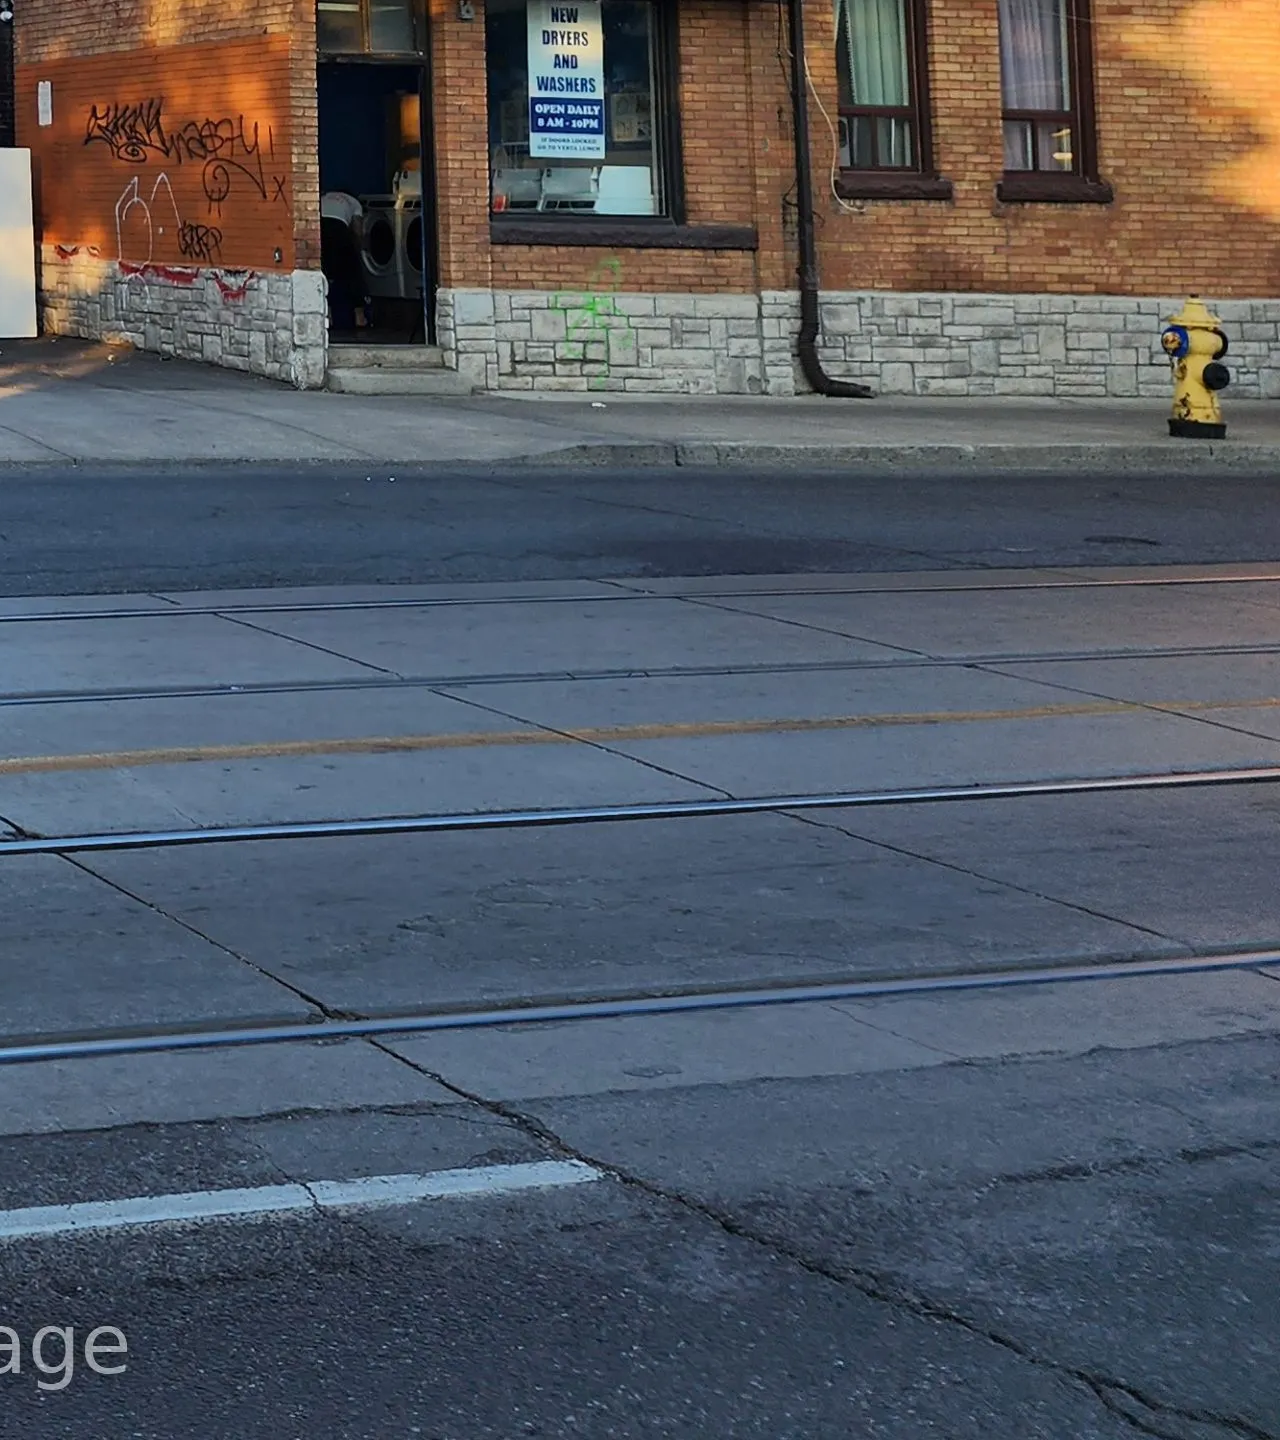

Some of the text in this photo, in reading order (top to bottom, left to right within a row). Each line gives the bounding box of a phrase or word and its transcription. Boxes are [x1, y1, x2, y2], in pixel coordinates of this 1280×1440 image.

[551, 7, 578, 23] NEW
[542, 29, 589, 47] DRYERS
[553, 53, 578, 69] AND
[536, 76, 596, 93] WASHERS
[535, 103, 600, 115] OPEN DAILY
[537, 117, 545, 127] 8
[546, 117, 564, 128] AM
[571, 118, 599, 129] 10PM
